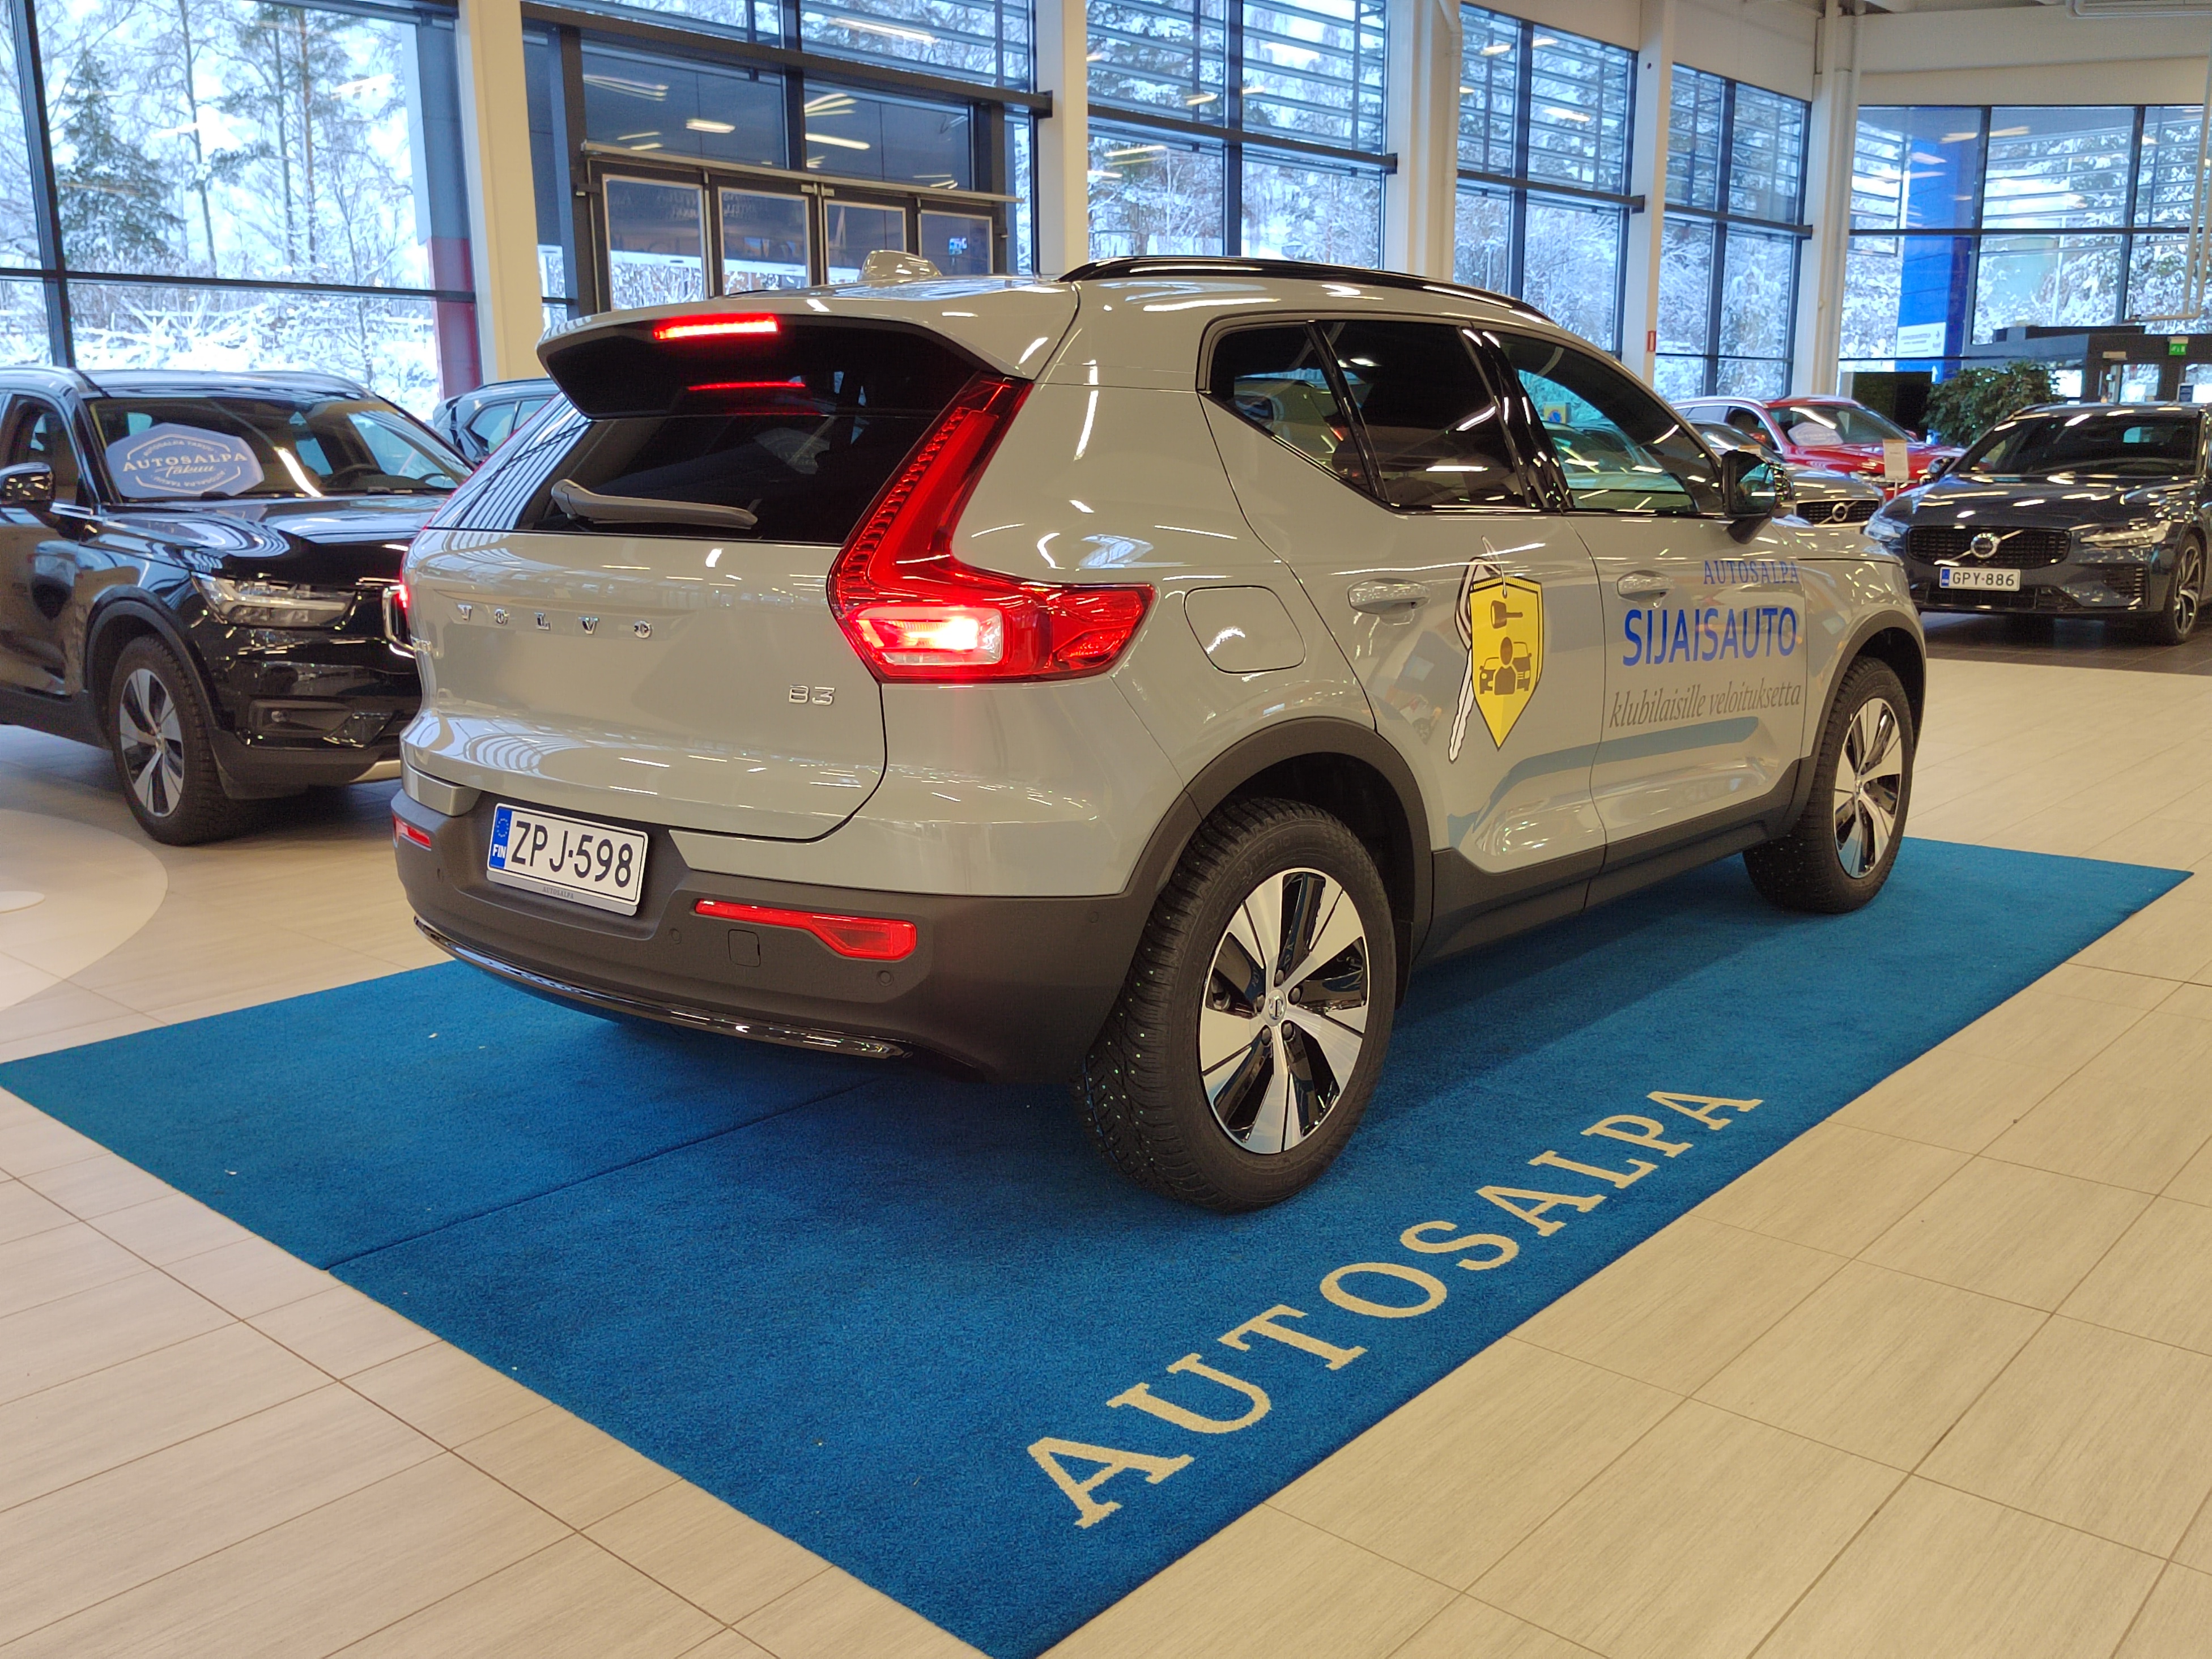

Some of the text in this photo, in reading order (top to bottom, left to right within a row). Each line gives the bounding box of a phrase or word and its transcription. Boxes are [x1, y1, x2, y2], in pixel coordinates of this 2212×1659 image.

[122, 452, 248, 472] AUTOSALPA
[1703, 560, 1800, 585] AUTOSALPA
[1952, 572, 2015, 586] GPY-886
[457, 603, 653, 639] VOLVO
[1622, 607, 1797, 667] SIJAISAUTO
[789, 684, 835, 706] B3
[1608, 677, 1802, 729] klubilaisille veloituksetta
[492, 843, 507, 858] FIN
[511, 820, 633, 888] ZPJ-598
[542, 886, 574, 899] AUTOSALPA
[1027, 1090, 1763, 1528] AUTOSALPA
